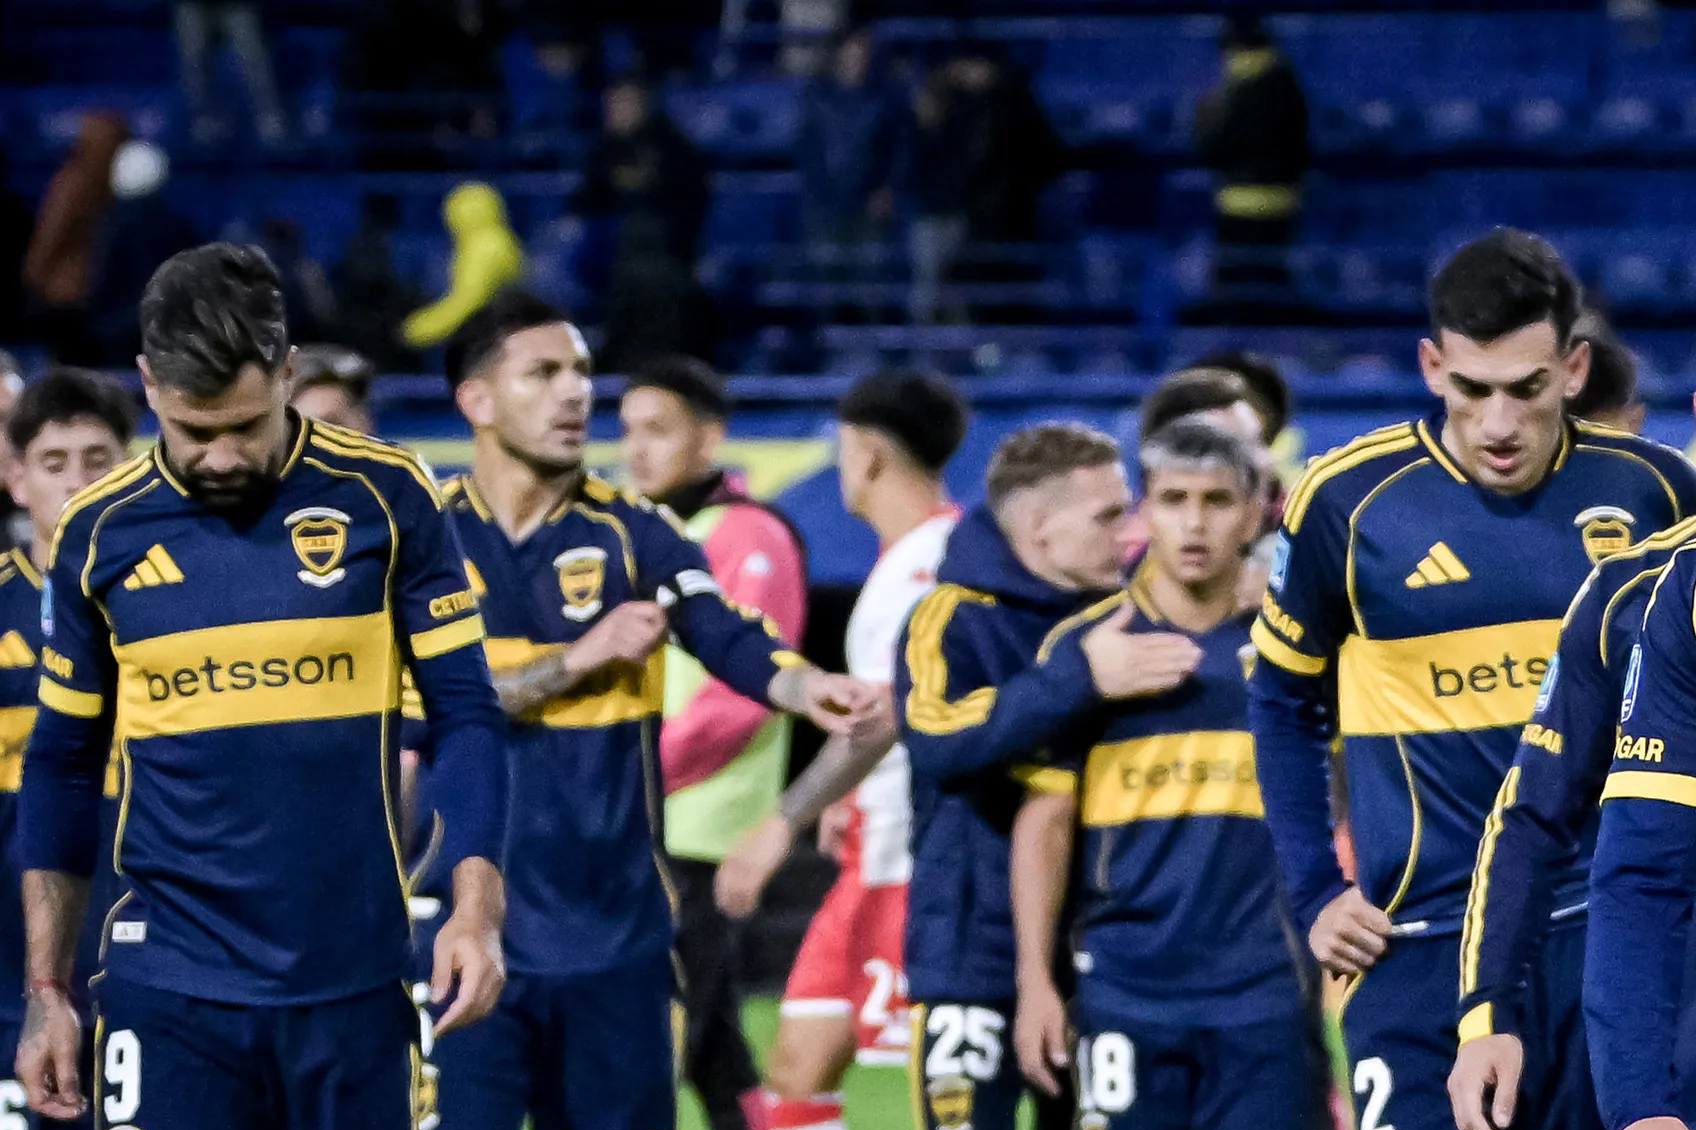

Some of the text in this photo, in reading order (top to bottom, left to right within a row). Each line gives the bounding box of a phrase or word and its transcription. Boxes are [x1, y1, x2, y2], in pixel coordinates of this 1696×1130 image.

[139, 651, 354, 702] betsson
[1614, 724, 1664, 762] GAR
[925, 1003, 1005, 1082] 25
[104, 1029, 142, 1124] 9
